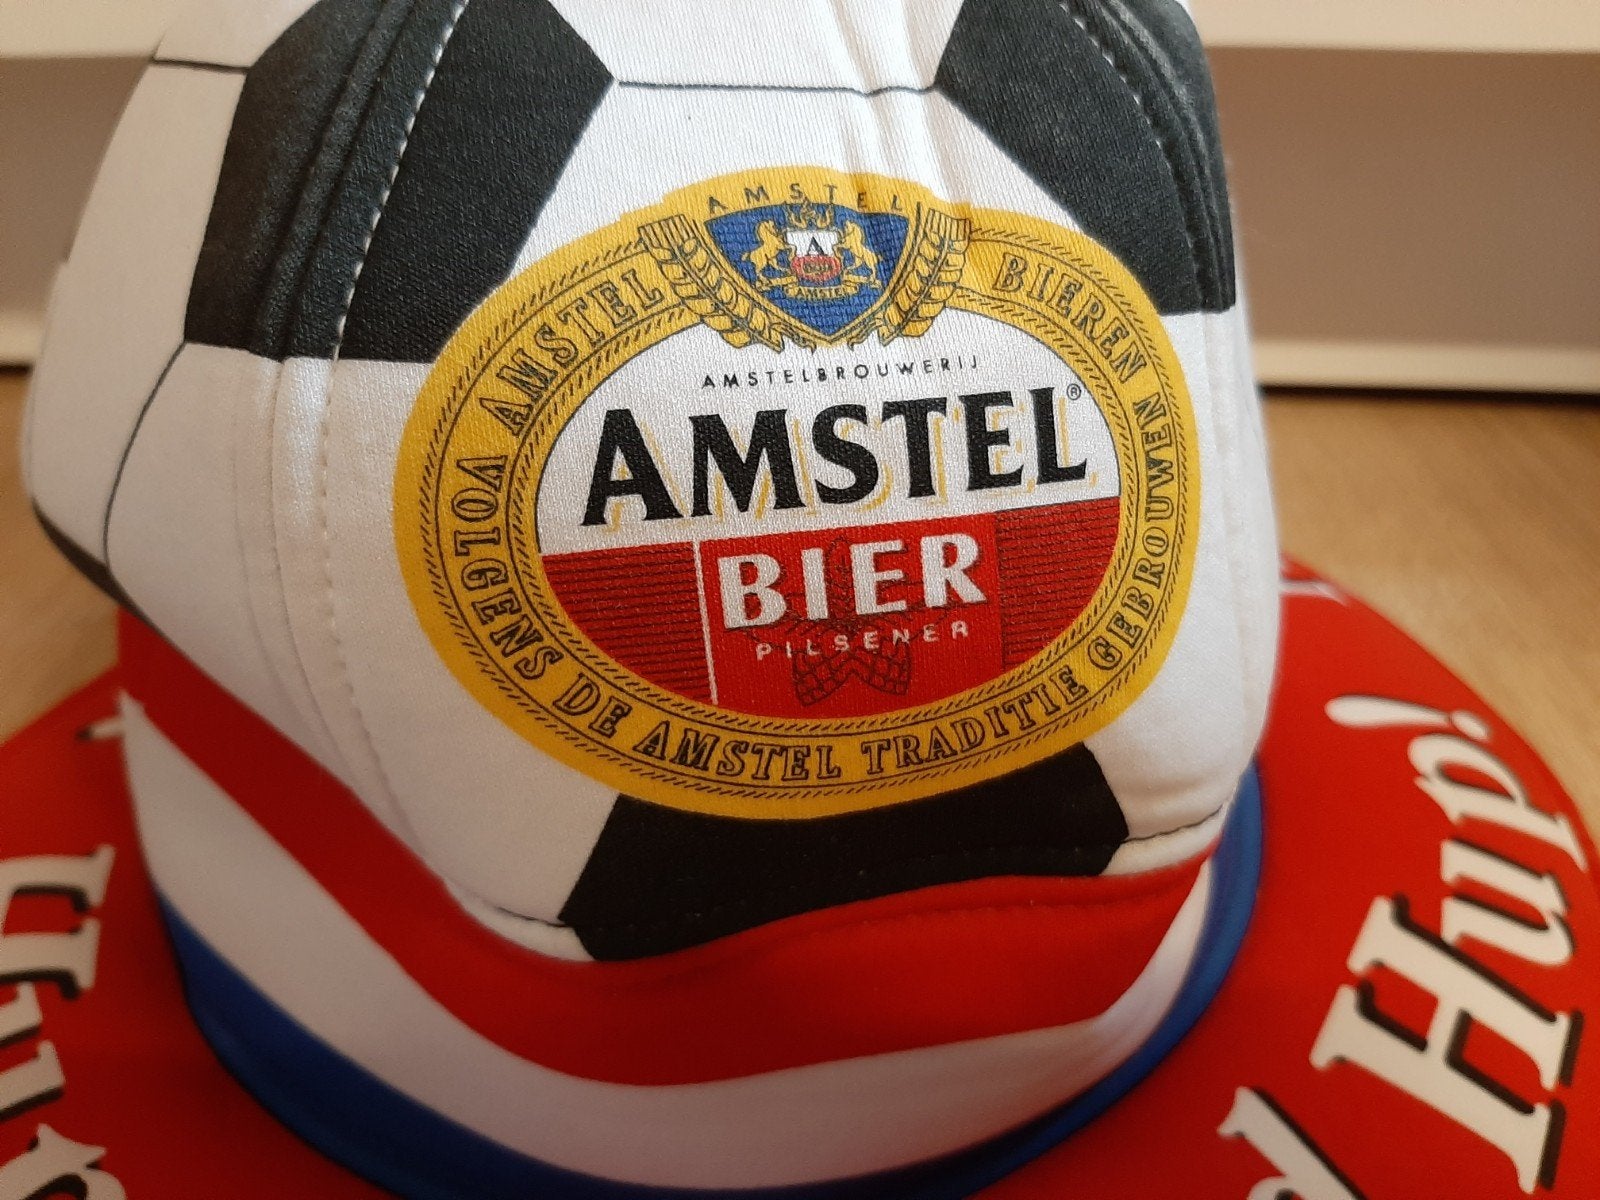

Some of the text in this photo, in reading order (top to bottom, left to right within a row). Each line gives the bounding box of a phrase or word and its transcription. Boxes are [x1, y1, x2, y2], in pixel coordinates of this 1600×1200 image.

[708, 183, 903, 214] AMSTEL
[481, 252, 1147, 437] AMSTEL BIEREN
[702, 355, 979, 388] AMSTELBROUWERIJ
[581, 386, 1088, 526] AMSTEL
[451, 391, 1174, 782] VOLGENS DE AMSTEL TRADITIE GEBROUWEN
[717, 533, 987, 630] BIER
[755, 621, 969, 662] PILSENER
[1309, 694, 1589, 1195] Hup!
